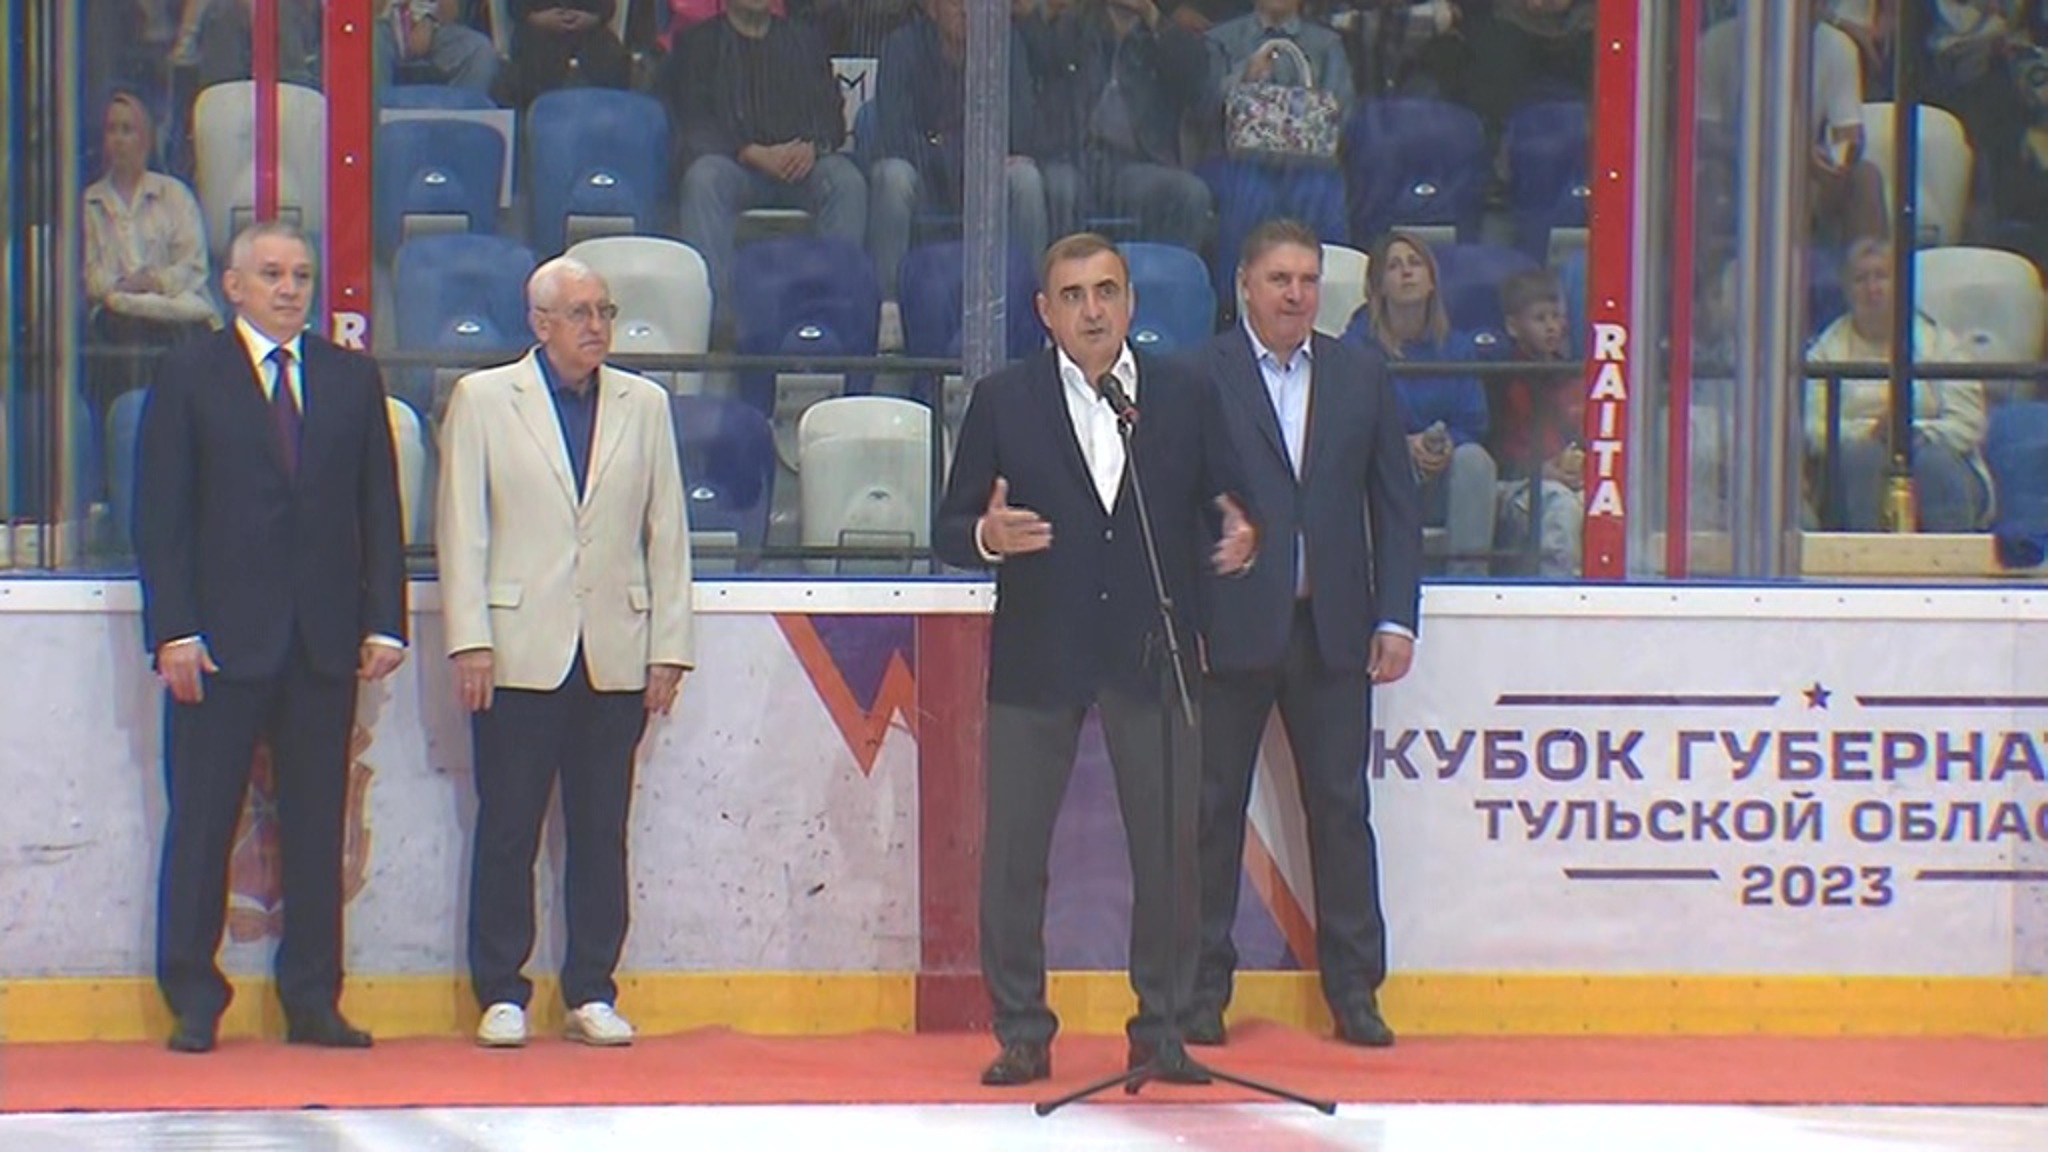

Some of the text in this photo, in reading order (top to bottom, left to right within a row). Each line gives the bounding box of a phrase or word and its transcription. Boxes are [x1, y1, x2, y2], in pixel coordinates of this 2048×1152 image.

[1588, 323, 1627, 516] RAITA
[1372, 729, 2048, 781] КУБОК ГУБЕРНА
[1474, 791, 1823, 842] ТУЛЬСКОЙ
[1742, 865, 1893, 907] 2023
